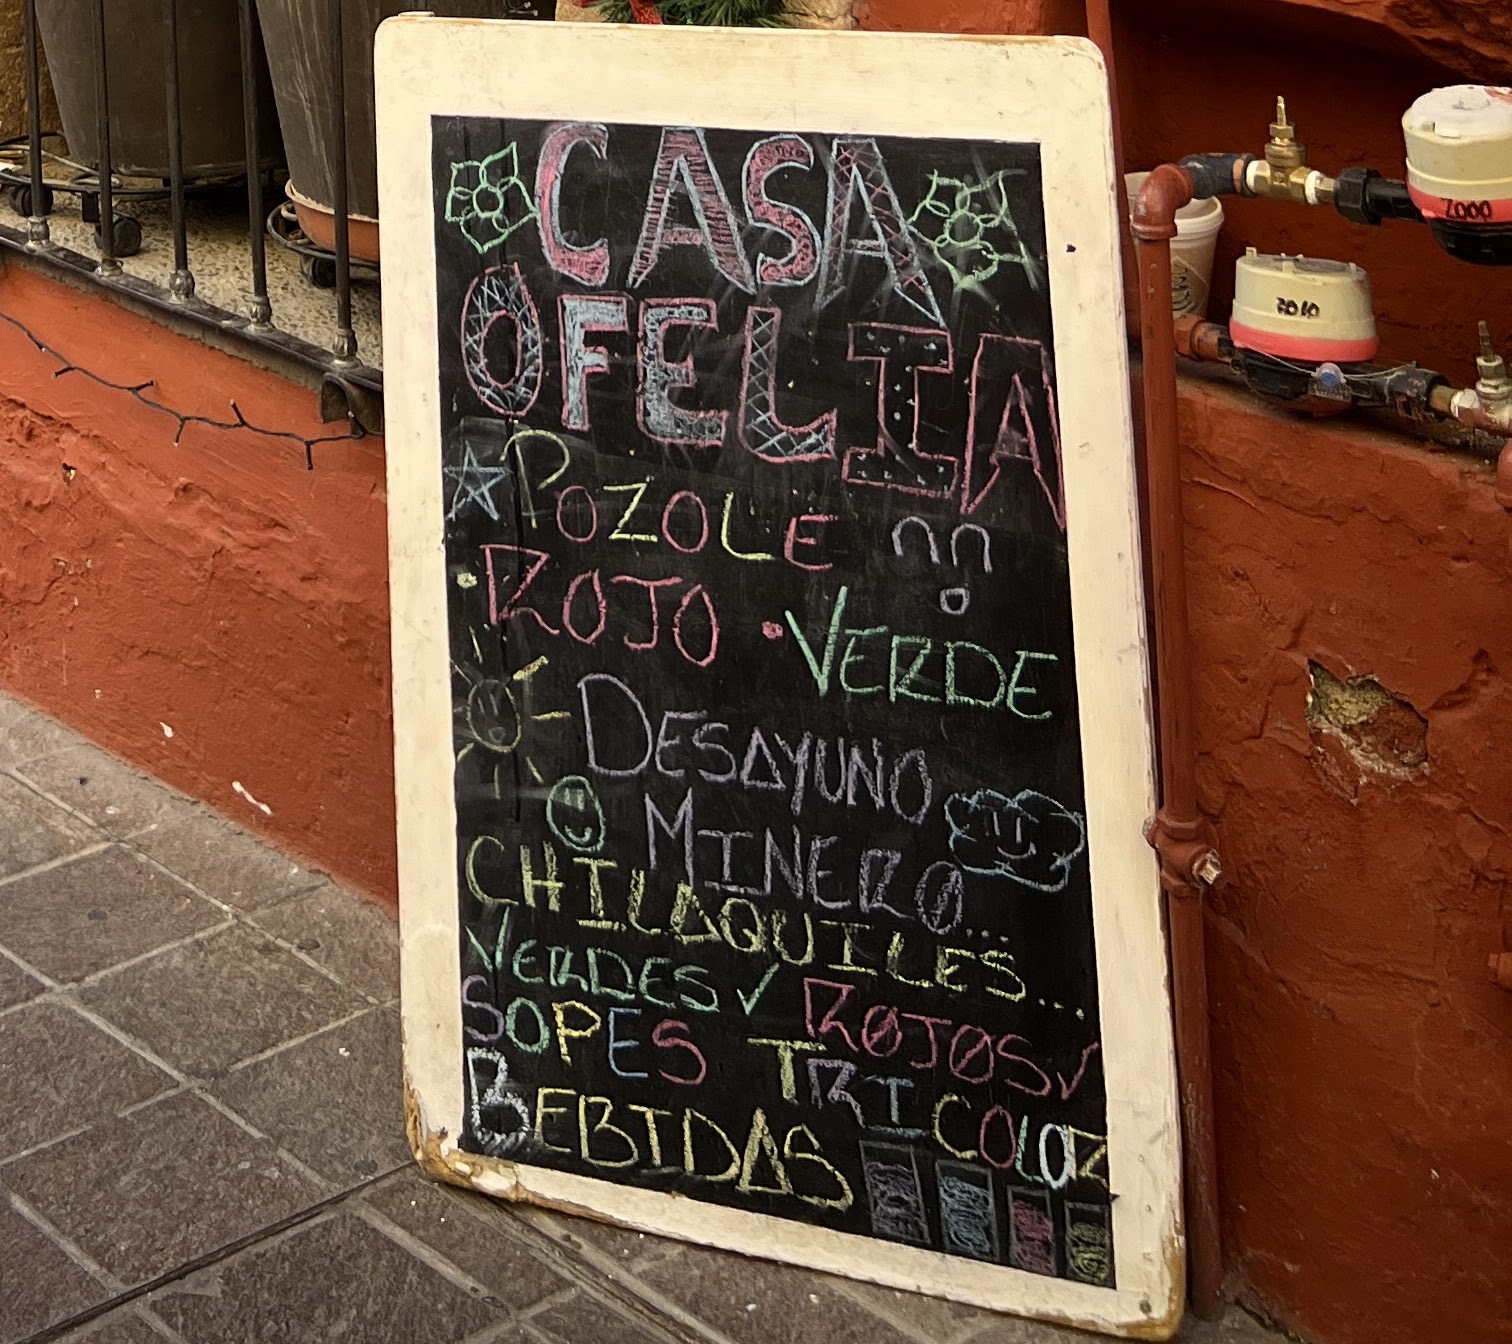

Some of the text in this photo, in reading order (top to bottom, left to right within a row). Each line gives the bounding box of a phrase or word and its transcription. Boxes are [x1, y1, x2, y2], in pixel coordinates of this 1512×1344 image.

[534, 122, 948, 328] CASA
[461, 262, 1067, 532] OFELIA
[501, 429, 837, 571] POZOLE
[480, 544, 1058, 719] ROJO VERDE
[577, 672, 934, 825] DESAYUNO
[460, 973, 708, 1085] SOPES
[464, 906, 1051, 1097] VERDES ROJOS
[465, 1046, 855, 1210] BEBIDAS
